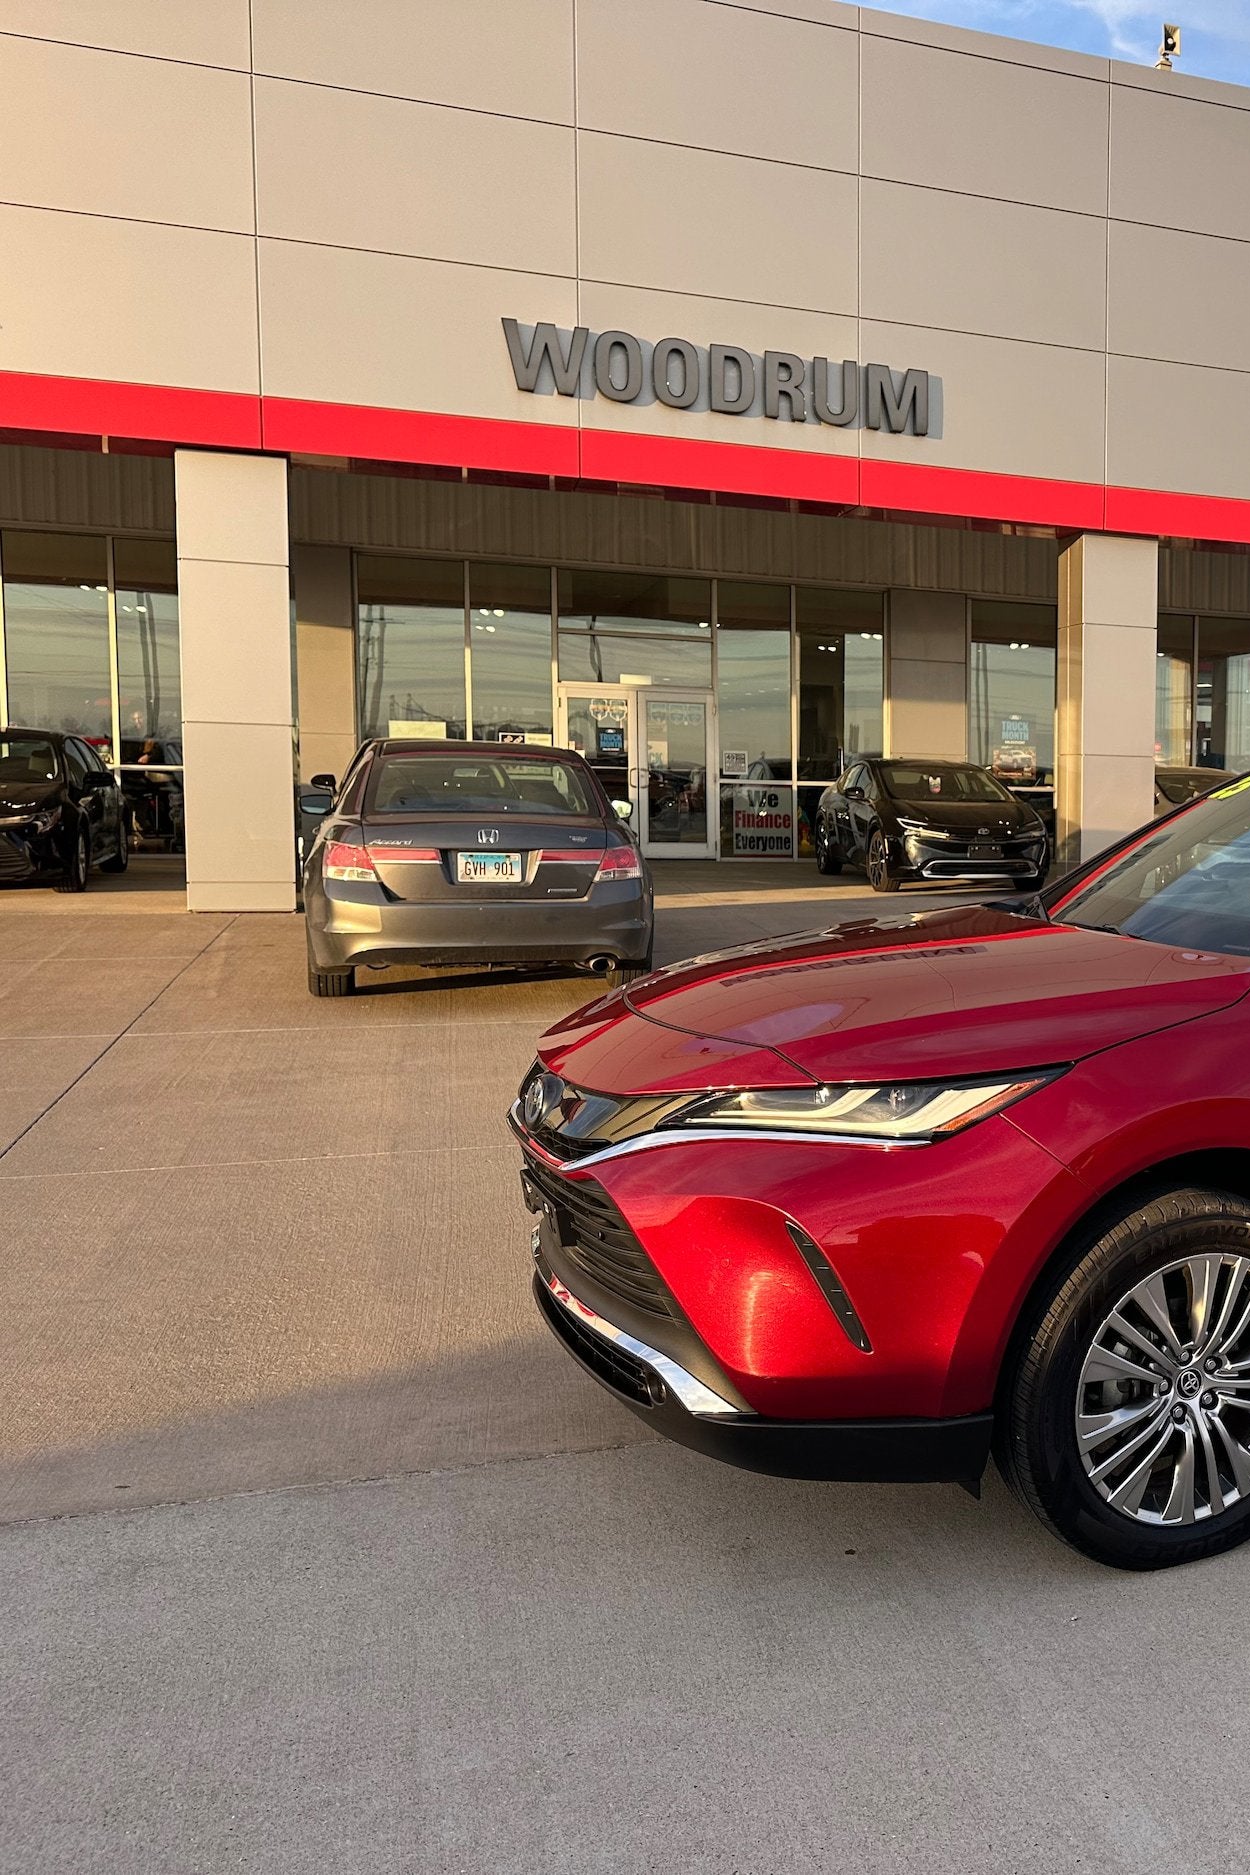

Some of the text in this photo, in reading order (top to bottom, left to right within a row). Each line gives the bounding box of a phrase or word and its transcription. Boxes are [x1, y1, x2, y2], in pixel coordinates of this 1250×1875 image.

[501, 317, 929, 436] WOODRUM
[1001, 720, 1029, 731] TRUCK
[1001, 731, 1029, 740] MONTH
[747, 789, 779, 808] We
[734, 809, 791, 829] Finance
[735, 833, 791, 852] Everyone
[464, 861, 515, 876] GVH 901
